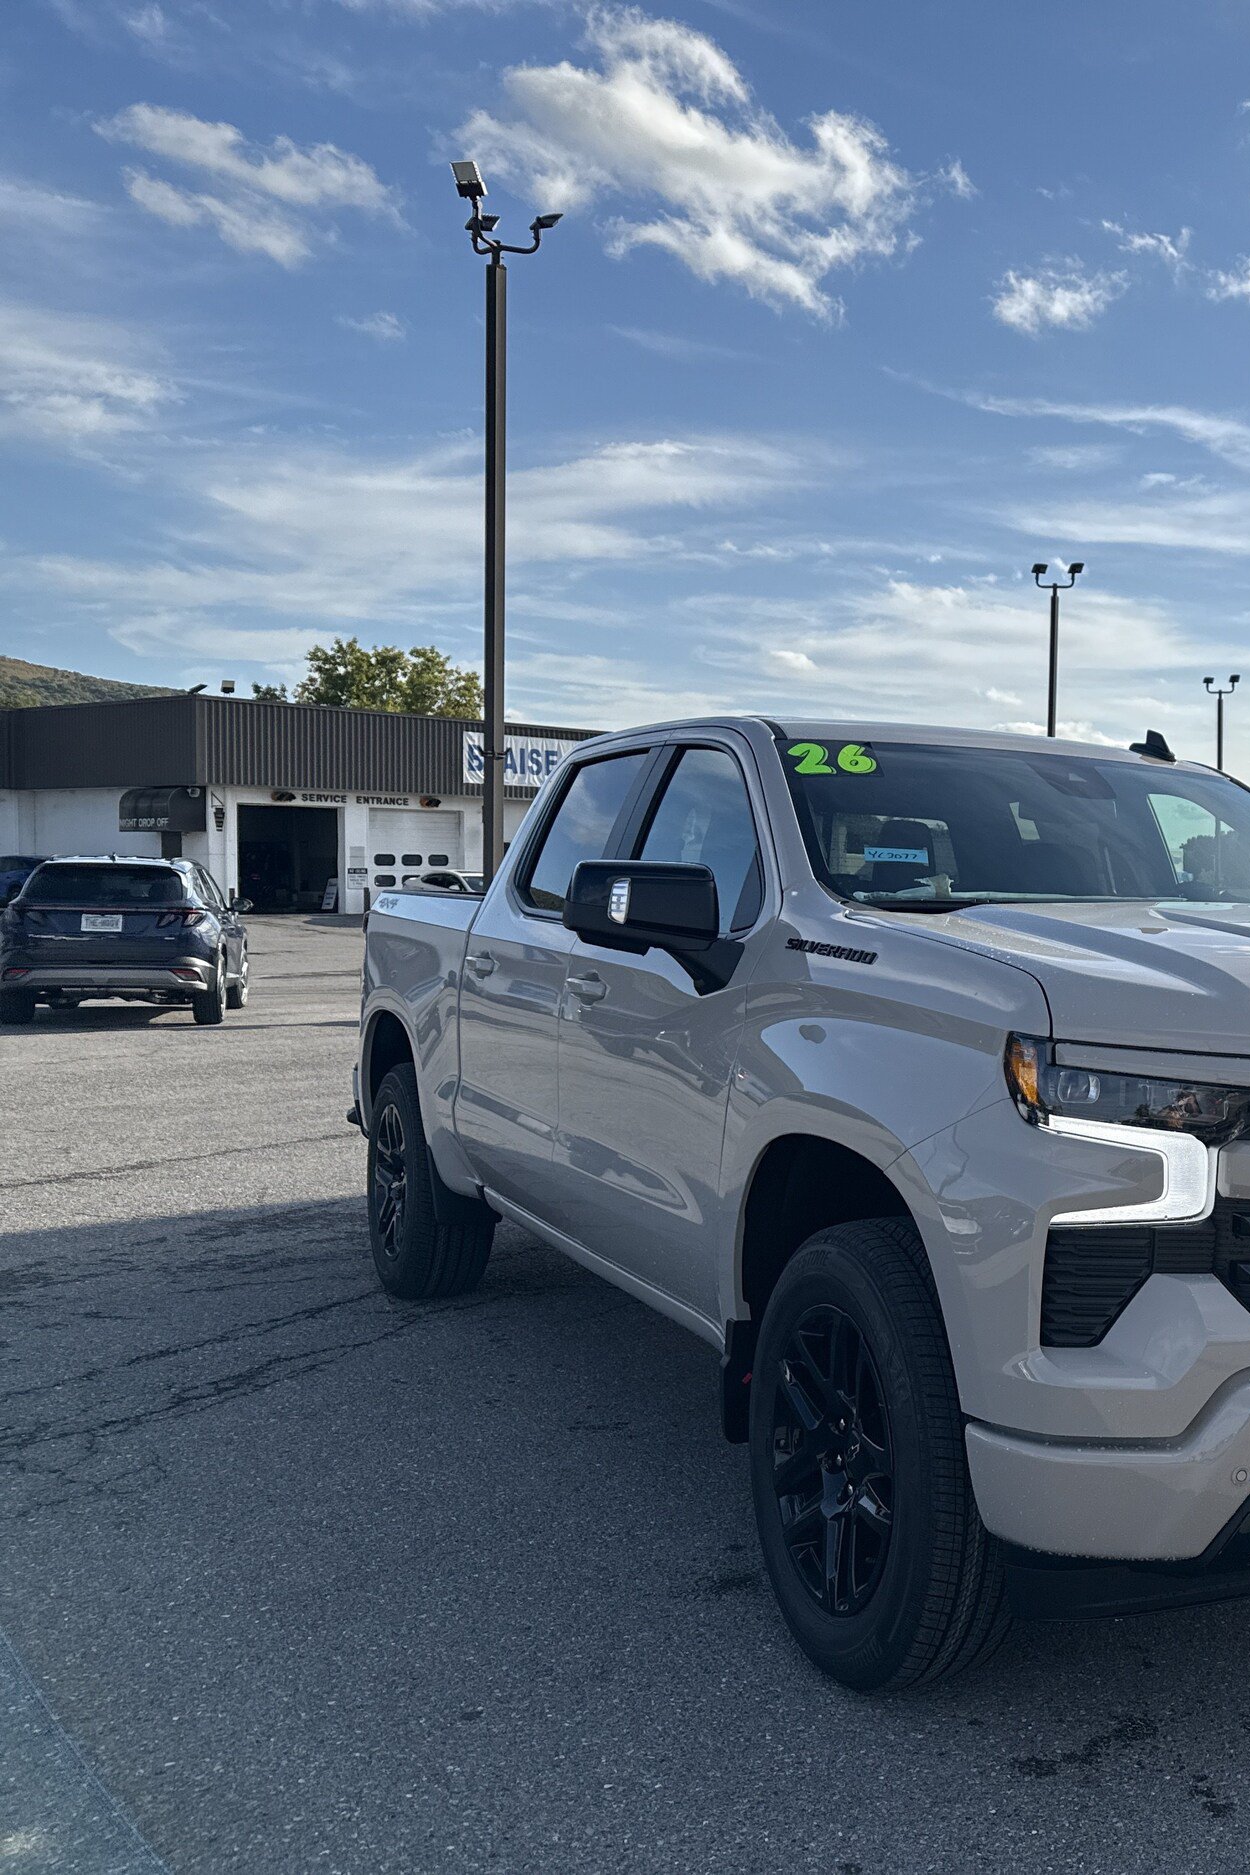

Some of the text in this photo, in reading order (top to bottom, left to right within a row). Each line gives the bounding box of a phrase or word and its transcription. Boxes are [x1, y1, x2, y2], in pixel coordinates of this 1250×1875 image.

[467, 744, 558, 776] BAISE
[787, 743, 877, 774] 26
[301, 793, 409, 806] SERVICE ENTRANCE
[138, 818, 155, 828] DROP
[156, 817, 169, 827] OFF
[785, 937, 878, 965] SILVERADO
